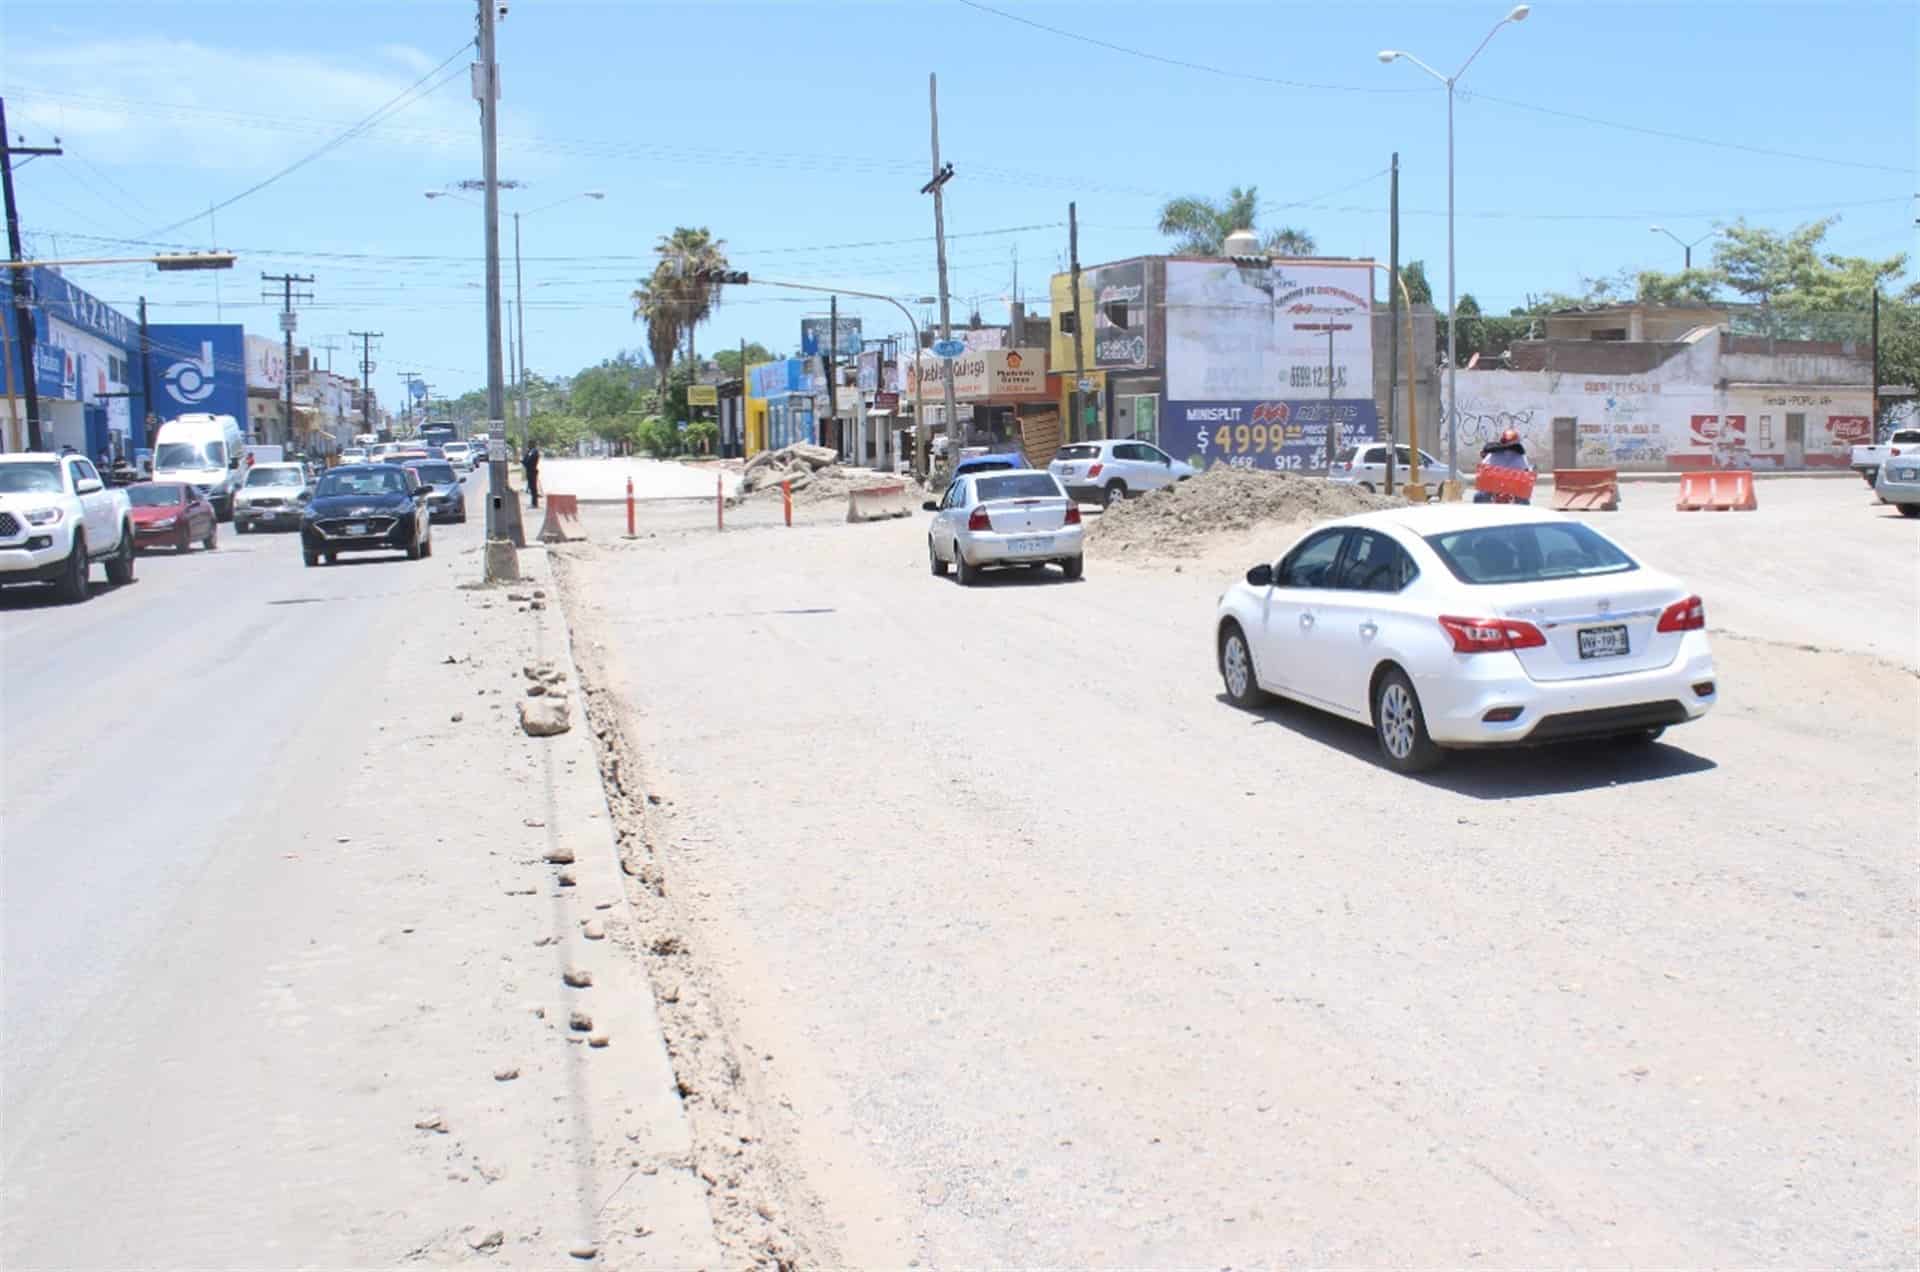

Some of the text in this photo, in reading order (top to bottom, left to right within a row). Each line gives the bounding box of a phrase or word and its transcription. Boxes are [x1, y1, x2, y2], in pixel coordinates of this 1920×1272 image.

[1186, 407, 1242, 421] MINISPLIT
[1214, 424, 1284, 454] 4999
[1275, 455, 1302, 470] 912
